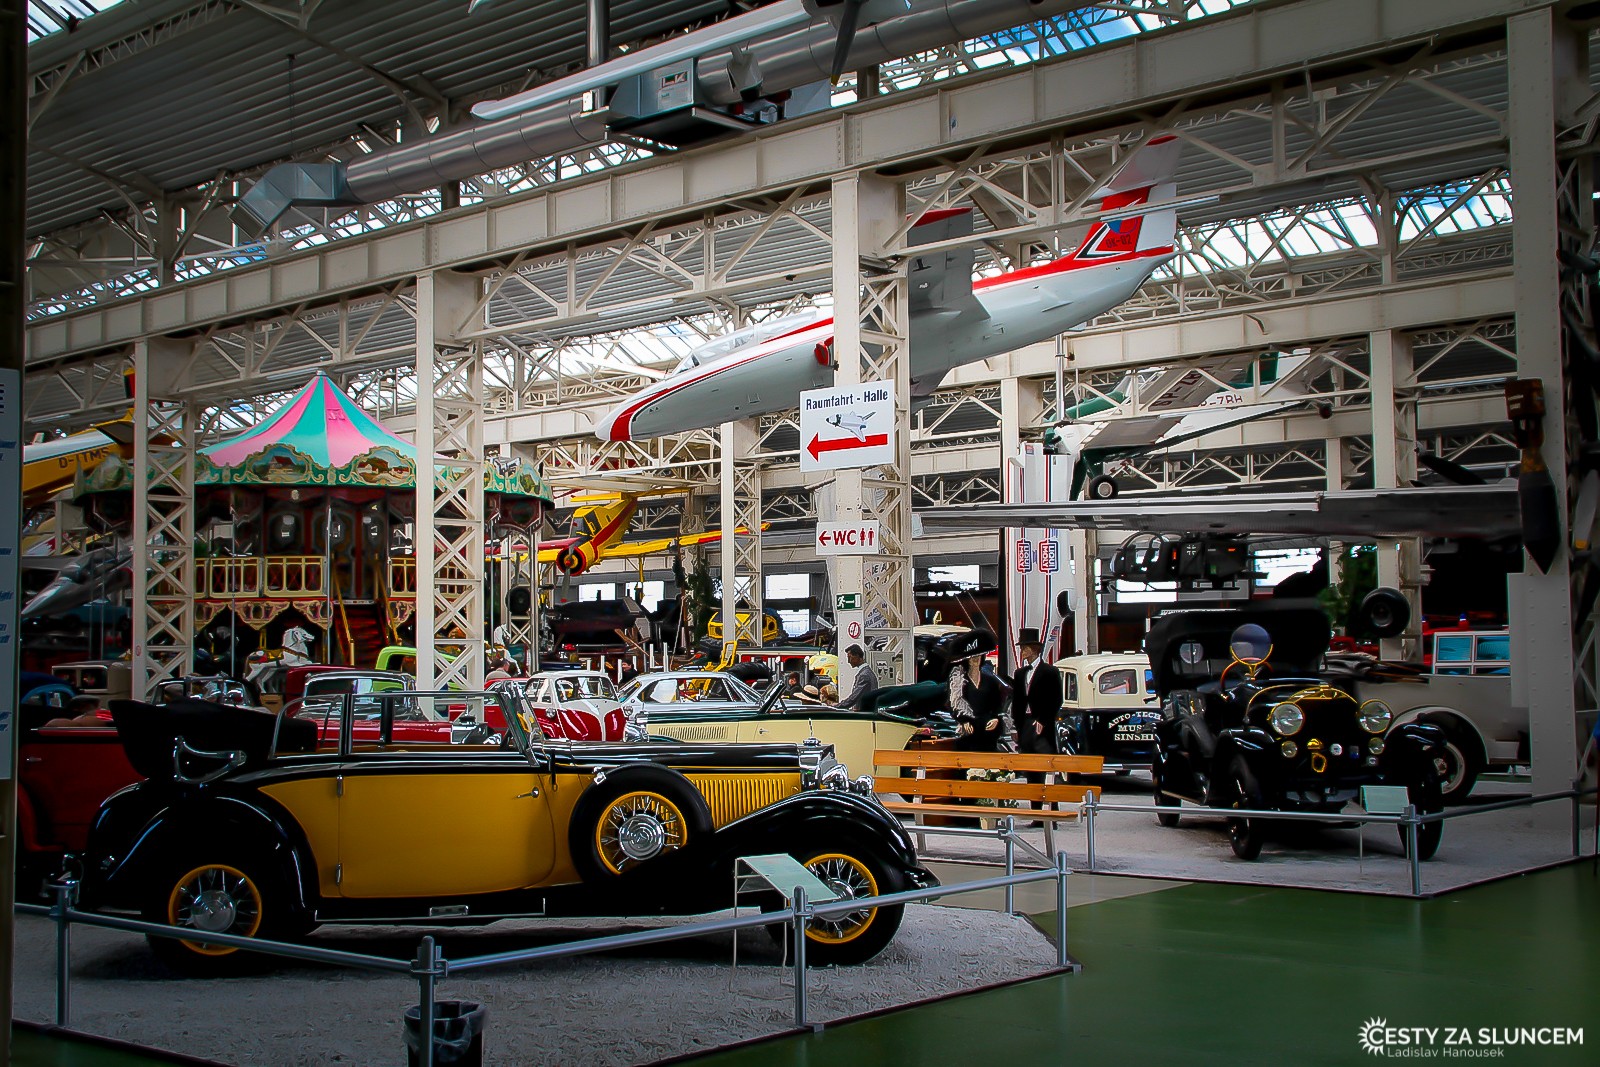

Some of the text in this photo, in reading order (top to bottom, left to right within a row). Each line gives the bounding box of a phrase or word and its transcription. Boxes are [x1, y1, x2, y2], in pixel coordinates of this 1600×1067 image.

[806, 393, 853, 410] Raumfahrt
[864, 389, 888, 403] Halle
[833, 530, 857, 546] WC
